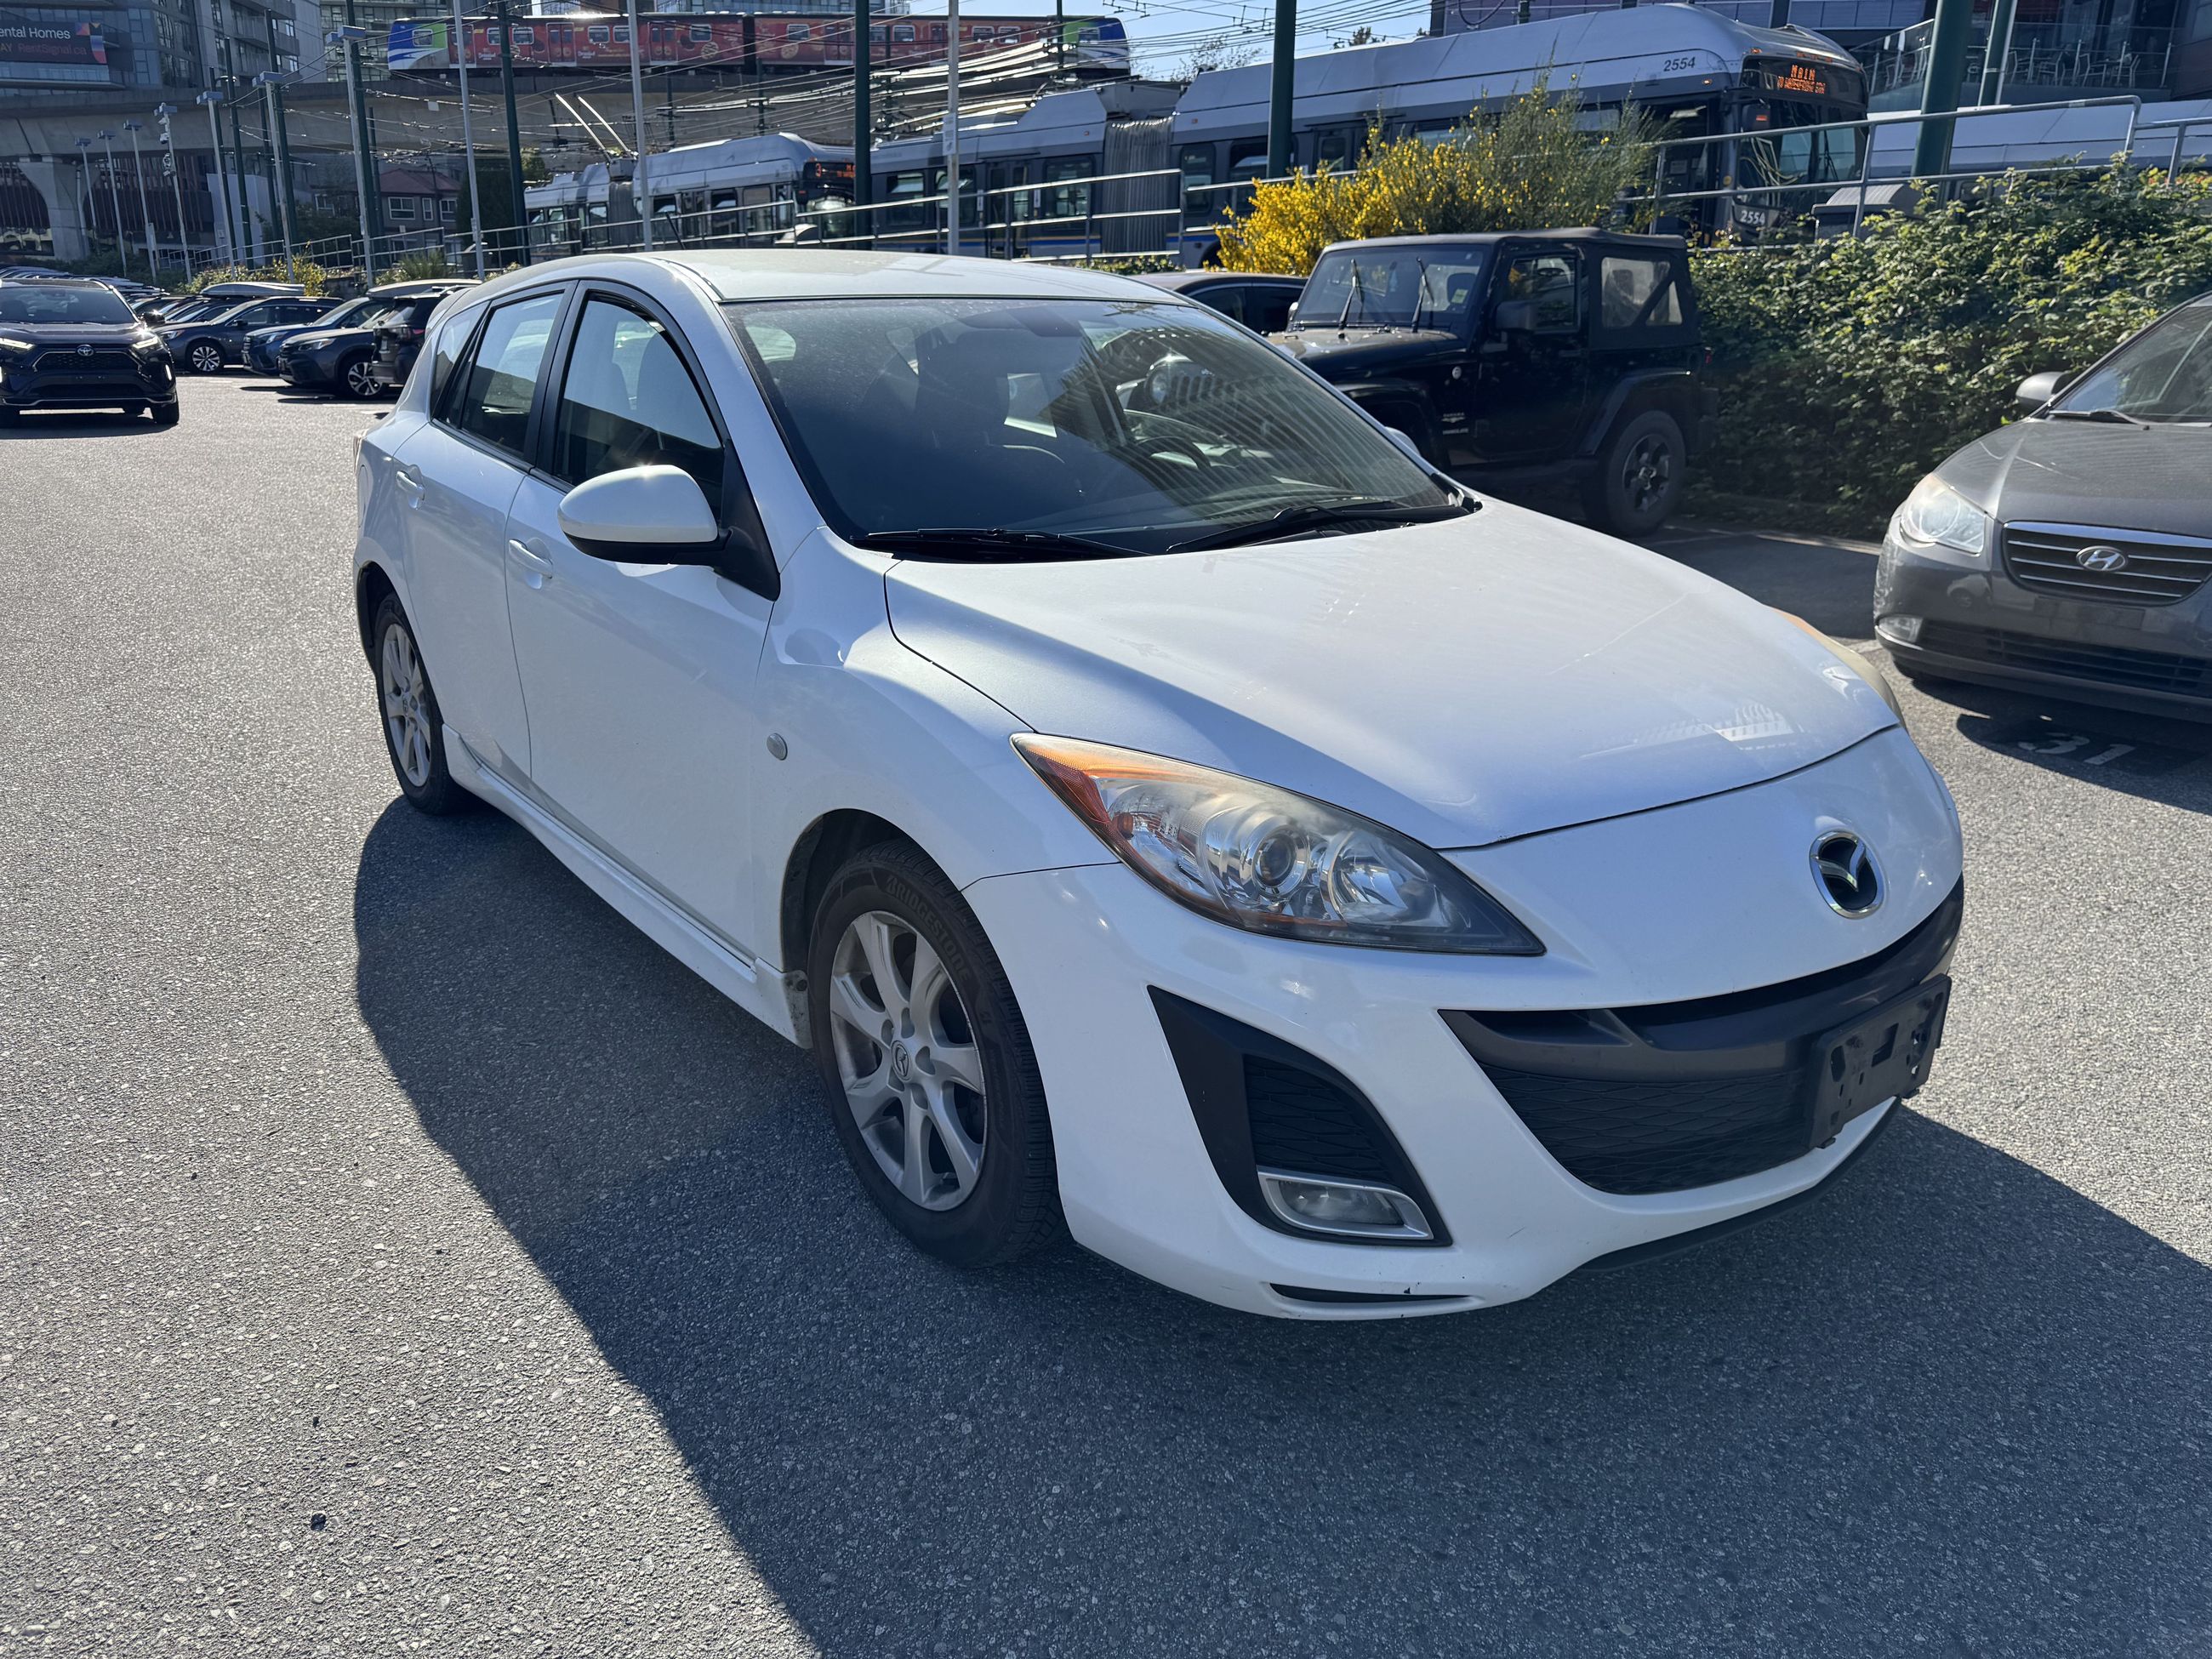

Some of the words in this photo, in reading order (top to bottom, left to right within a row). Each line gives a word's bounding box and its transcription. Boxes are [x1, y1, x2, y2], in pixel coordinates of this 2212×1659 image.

[28, 26, 71, 39] Homes
[1663, 56, 1696, 71] 2554
[1790, 64, 1816, 81] MAIN
[1740, 209, 1765, 225] 2554
[885, 874, 971, 981] BRIDGESTONE
